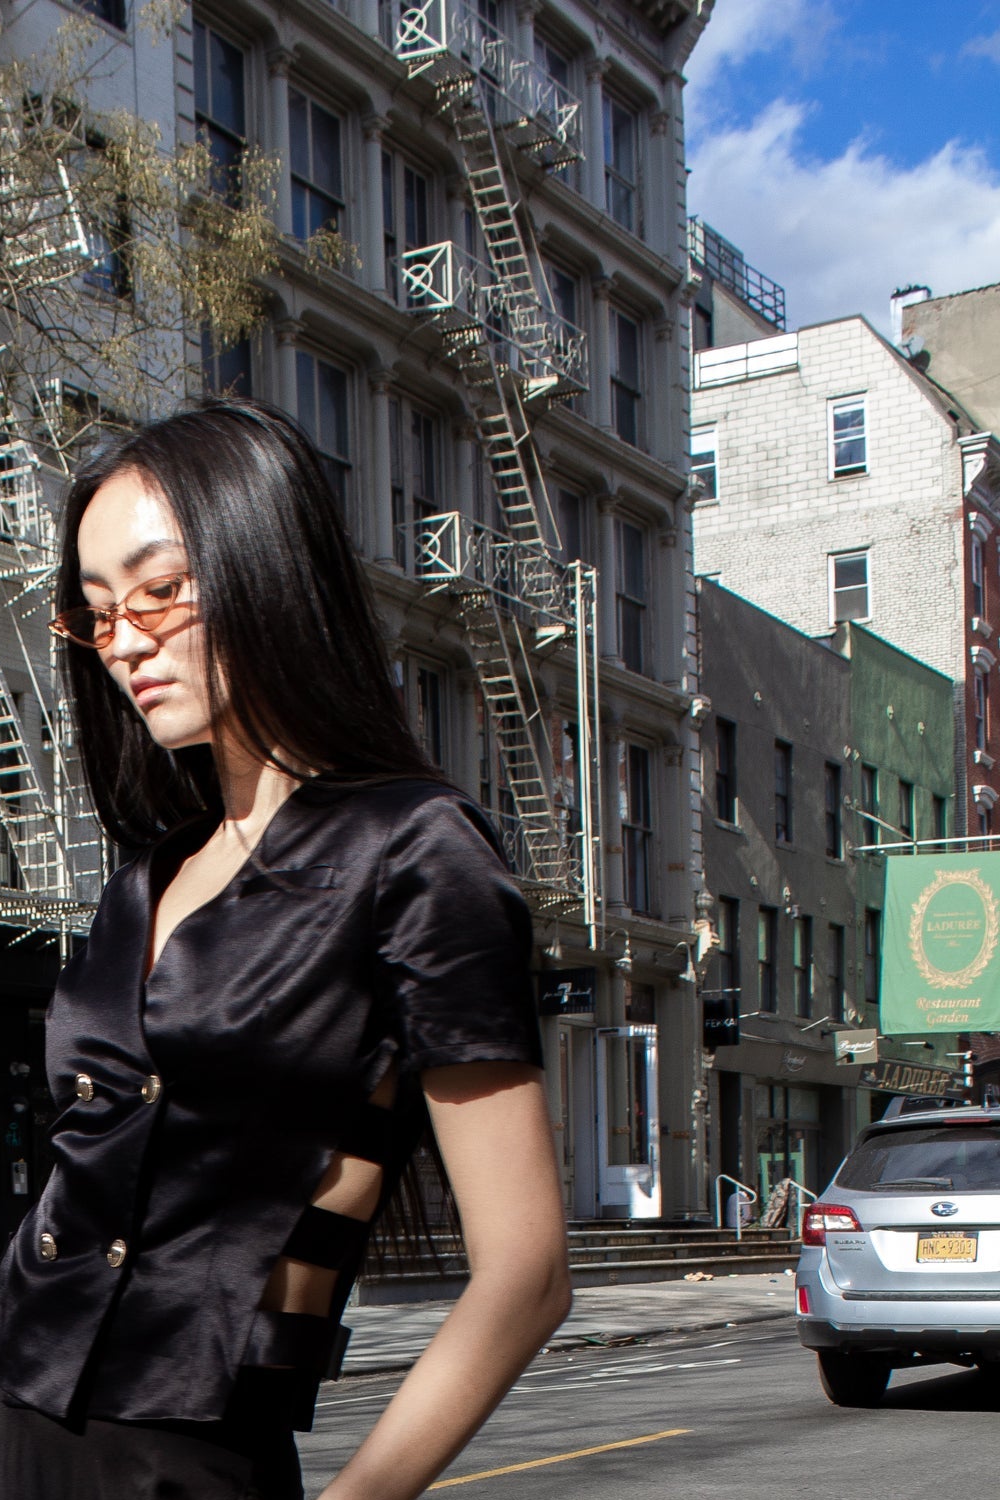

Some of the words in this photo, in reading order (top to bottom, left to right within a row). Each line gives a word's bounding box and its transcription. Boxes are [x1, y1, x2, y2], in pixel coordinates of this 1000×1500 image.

[557, 982, 572, 1004] 7
[916, 997, 981, 1010] Restaurant
[926, 1009, 969, 1028] Garden
